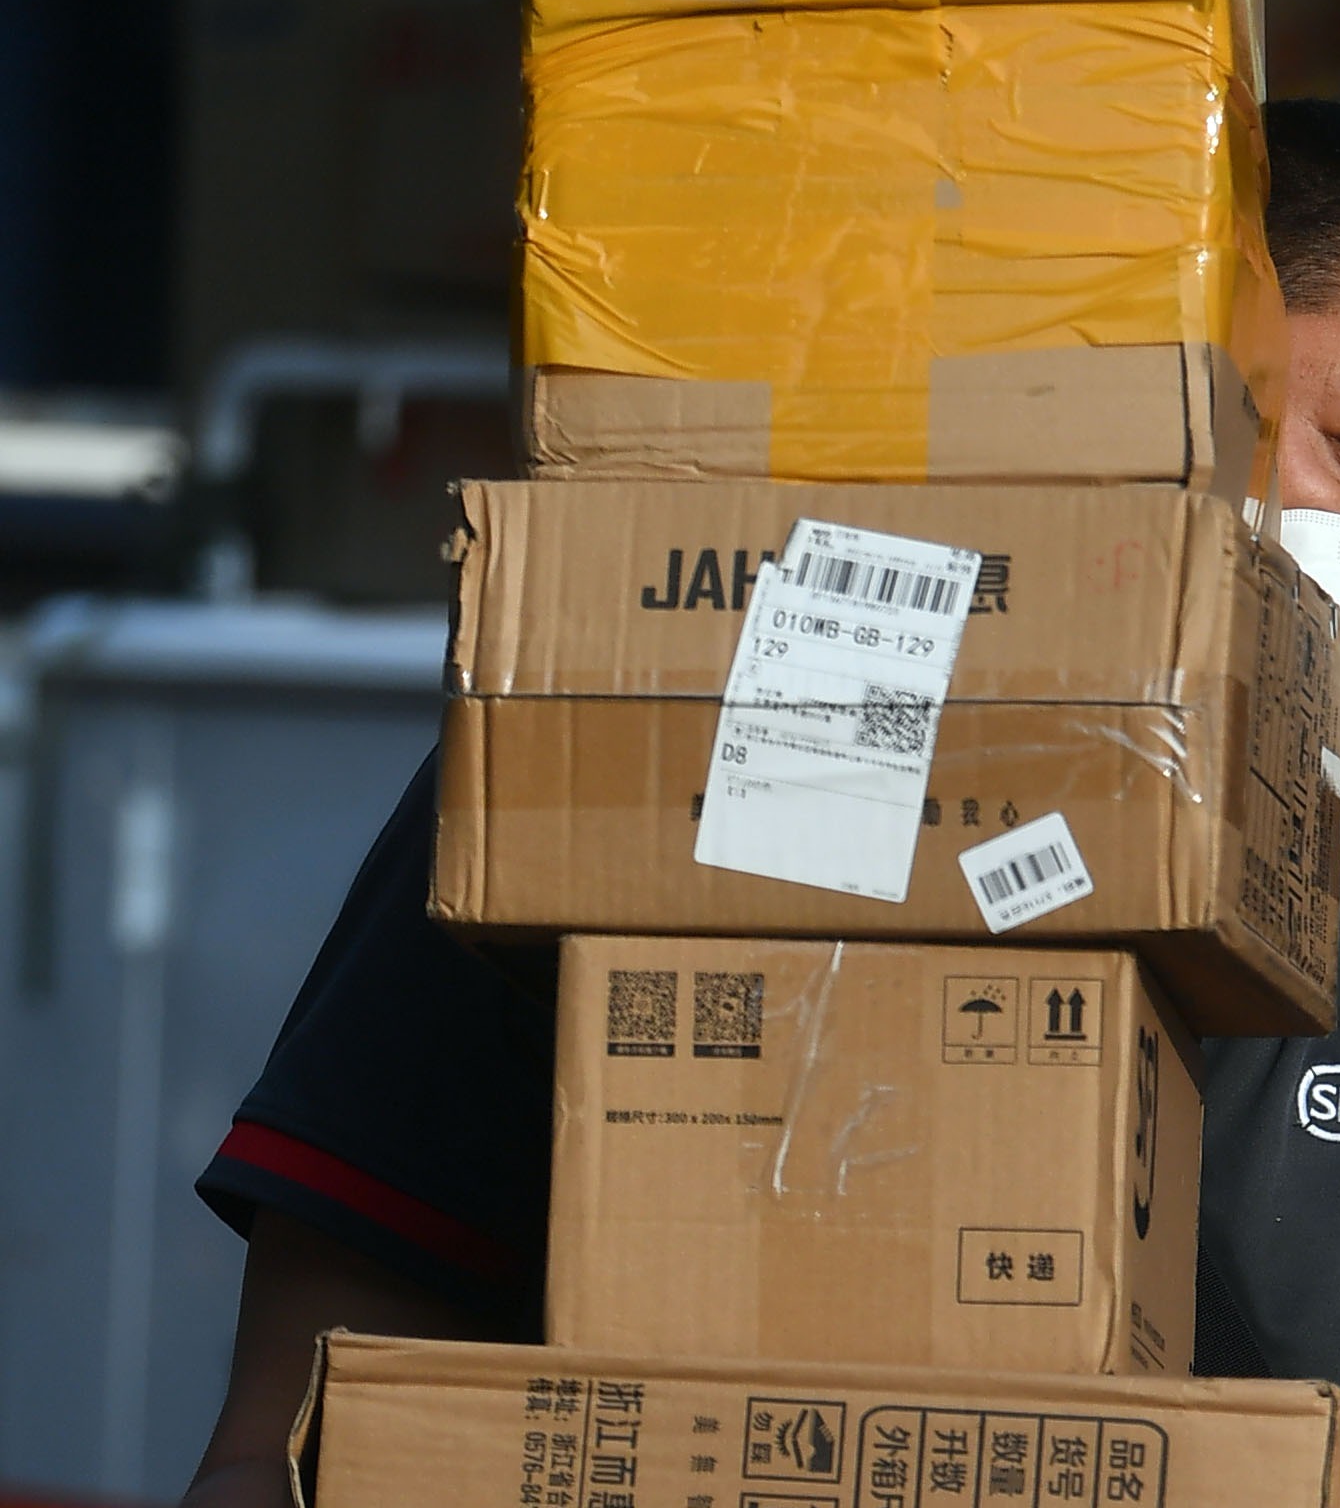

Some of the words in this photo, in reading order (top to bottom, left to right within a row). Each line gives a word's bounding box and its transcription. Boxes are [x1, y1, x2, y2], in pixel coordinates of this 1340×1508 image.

[752, 637, 790, 661] 129
[721, 741, 748, 767] D8
[985, 1252, 1056, 1283] 快递
[928, 1427, 969, 1495] 升数
[988, 1430, 1029, 1497] 数量
[1047, 1435, 1087, 1501] 货号
[1106, 1438, 1146, 1503] 品名
